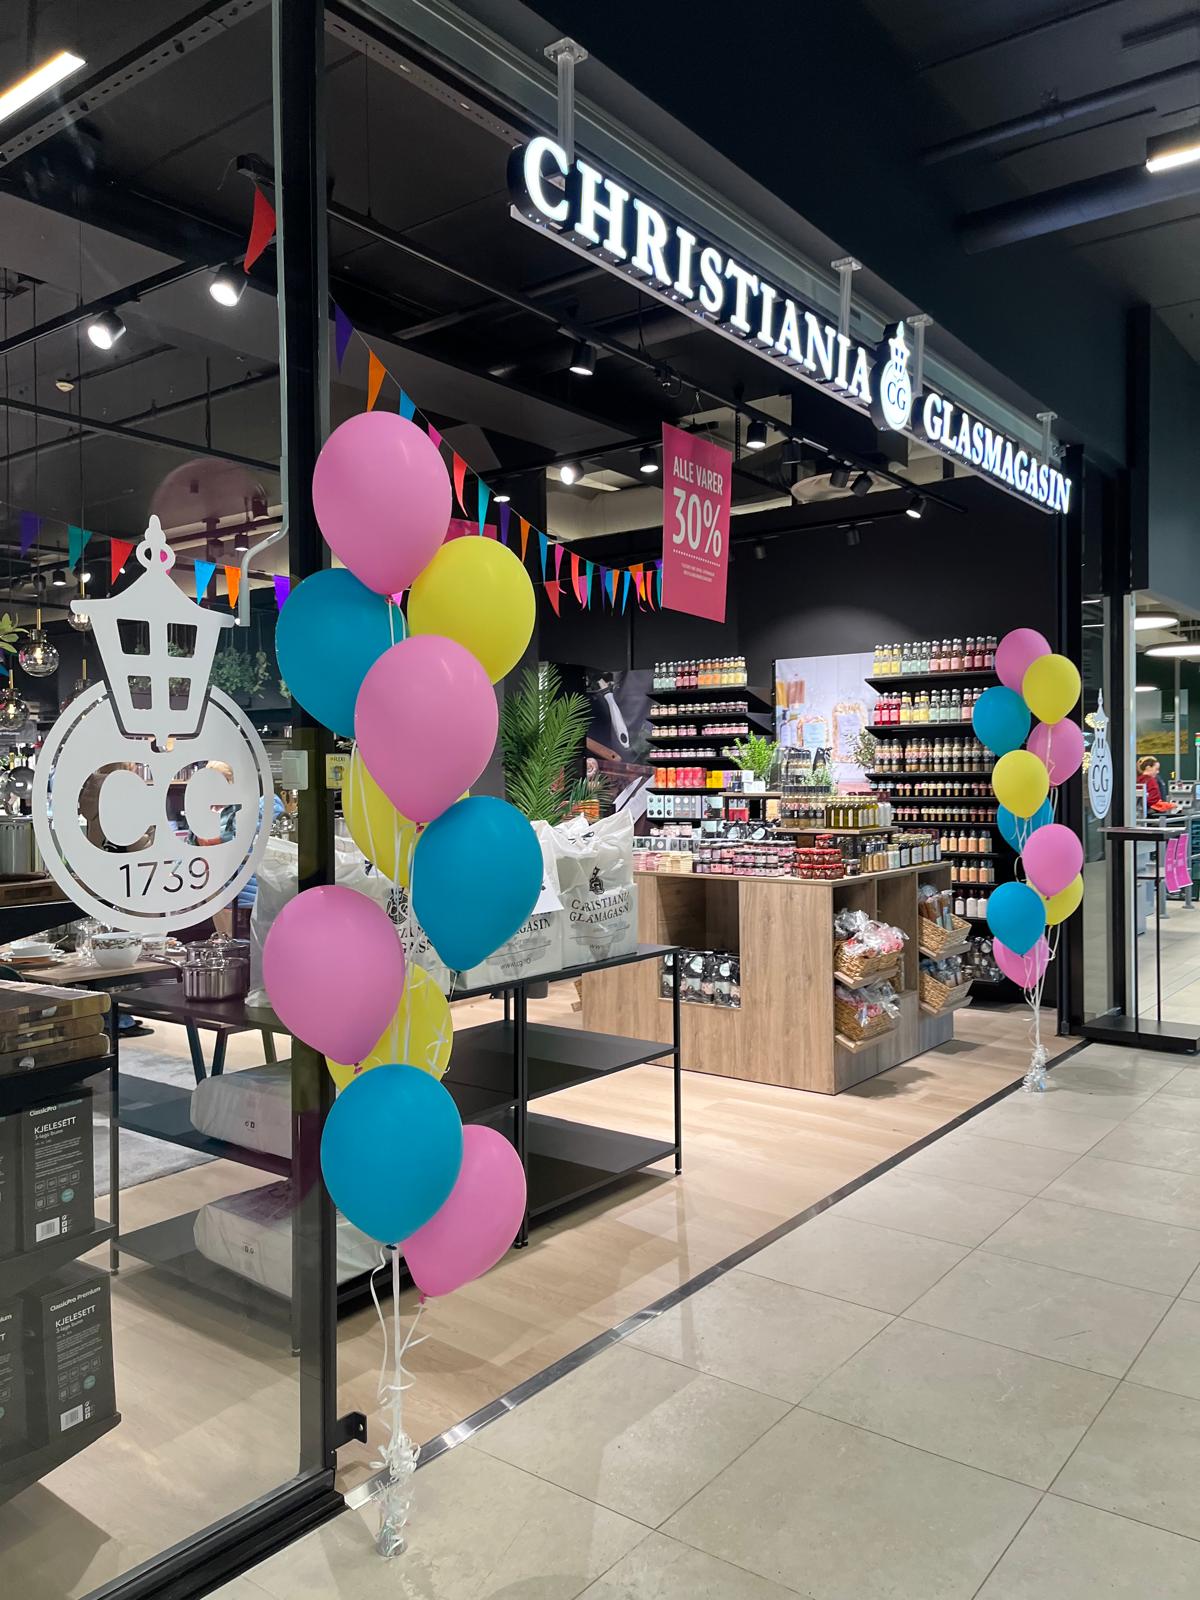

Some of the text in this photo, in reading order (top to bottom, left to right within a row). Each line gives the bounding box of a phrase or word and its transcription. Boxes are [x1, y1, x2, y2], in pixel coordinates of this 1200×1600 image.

[523, 136, 873, 404] CHRISTIANIA
[887, 381, 907, 411] CG
[923, 393, 1072, 515] GLASMAGASIN
[673, 456, 723, 496] ALLE VARER
[672, 487, 722, 558] 30%
[1092, 764, 1109, 793] CG
[77, 760, 242, 854] CG
[119, 856, 210, 898] 1739
[34, 1116, 77, 1134] KJELESETT
[55, 1304, 96, 1328] KJELESETT
